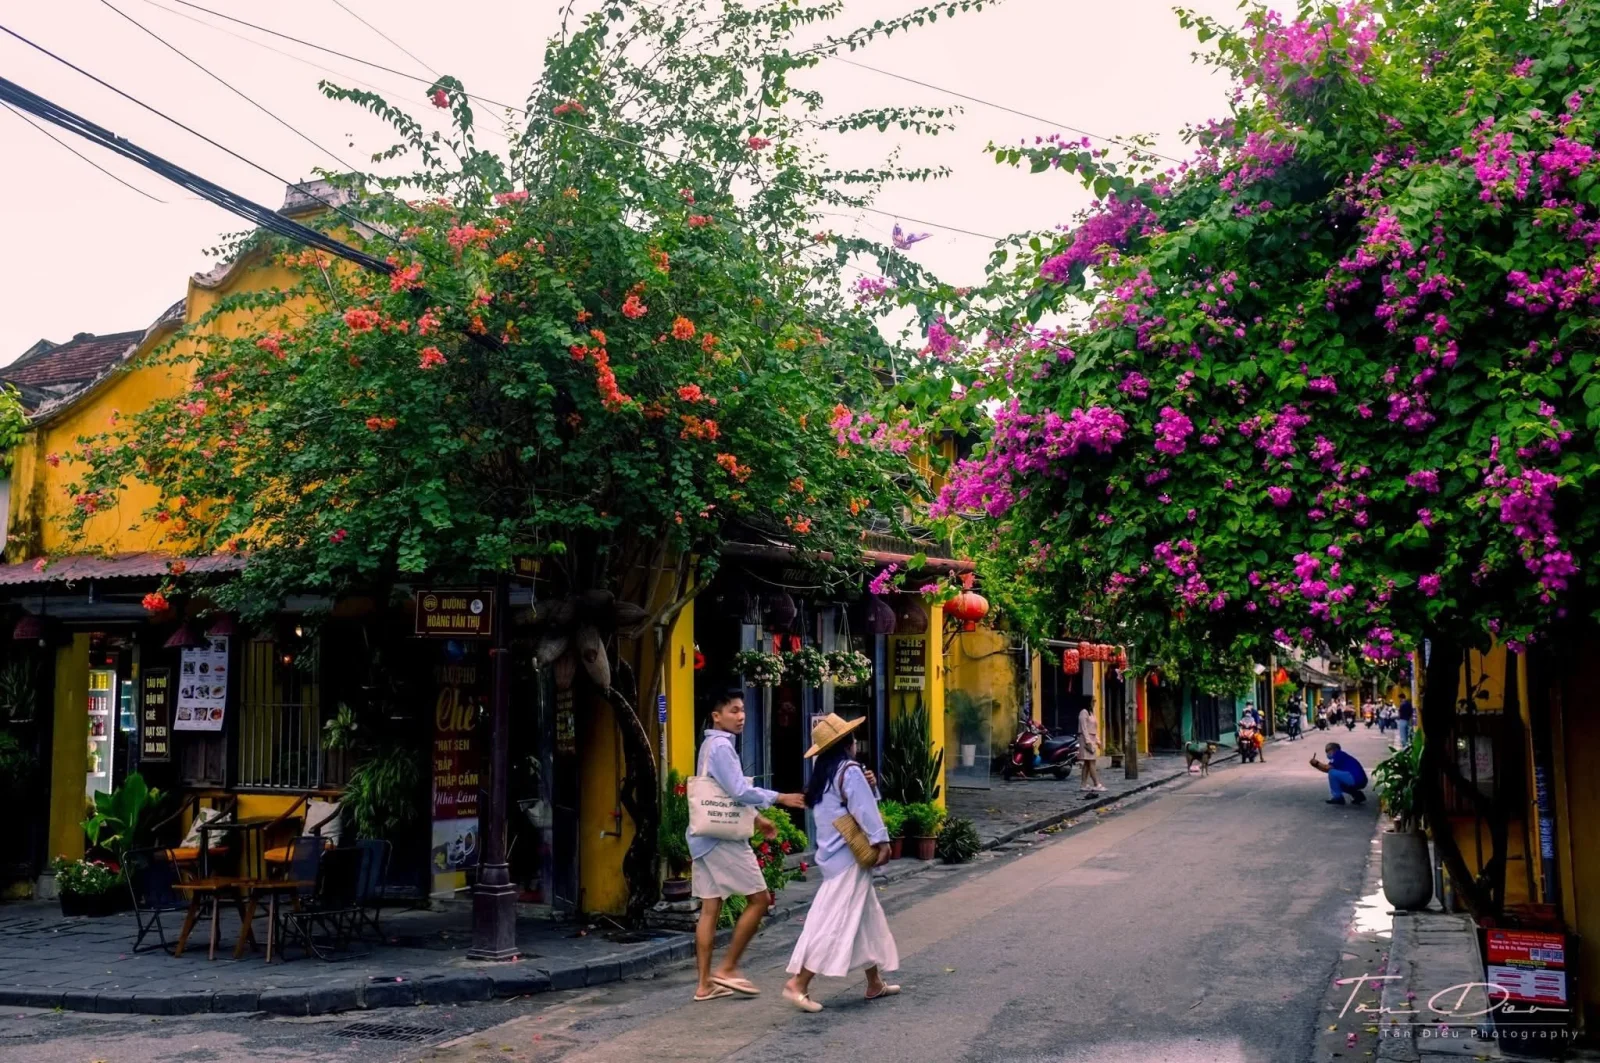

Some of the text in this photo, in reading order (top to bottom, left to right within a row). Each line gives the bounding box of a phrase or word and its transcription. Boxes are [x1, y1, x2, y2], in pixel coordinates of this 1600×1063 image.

[441, 596, 467, 610] ĐƯỜNG
[427, 612, 481, 630] HOÀNG VĂN THỤ
[436, 687, 476, 732] Chè
[145, 726, 167, 738] HẠT SEN
[454, 739, 470, 751] SEN
